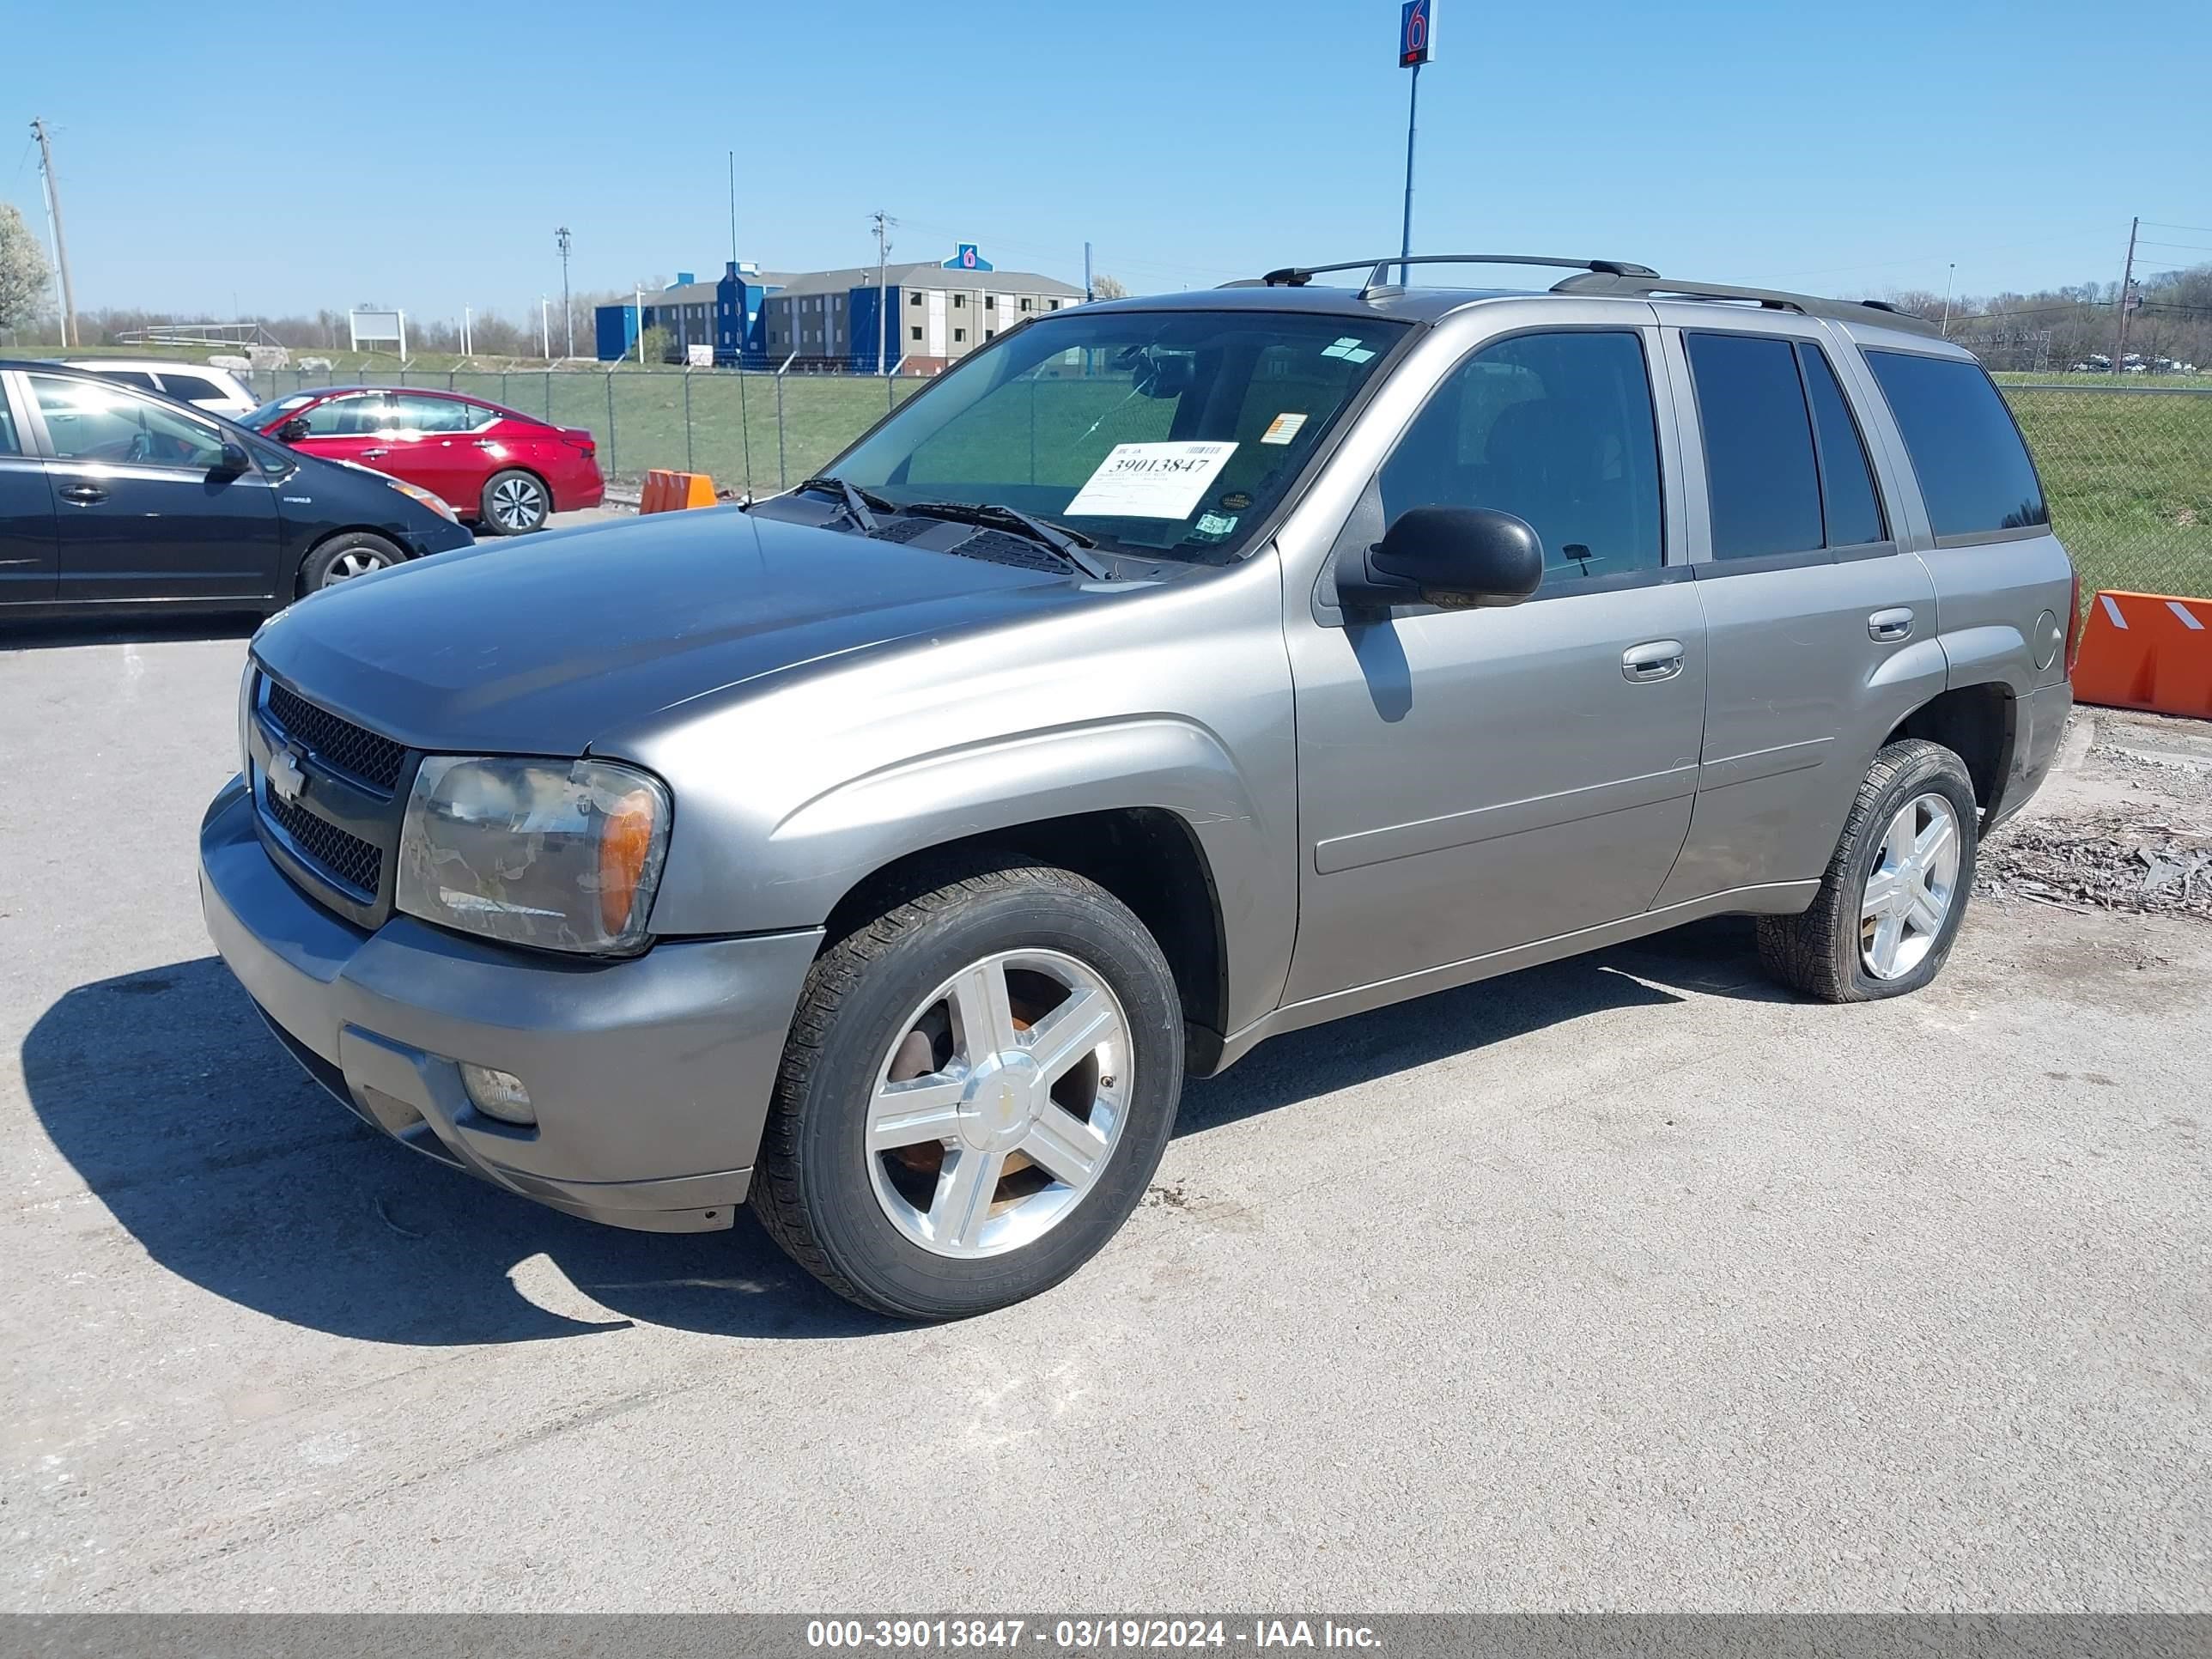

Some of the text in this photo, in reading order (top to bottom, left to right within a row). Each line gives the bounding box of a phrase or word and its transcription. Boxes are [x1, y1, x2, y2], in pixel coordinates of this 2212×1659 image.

[1407, 0, 1426, 52] 6
[963, 247, 975, 268] 6
[1108, 458, 1210, 473] 39013847
